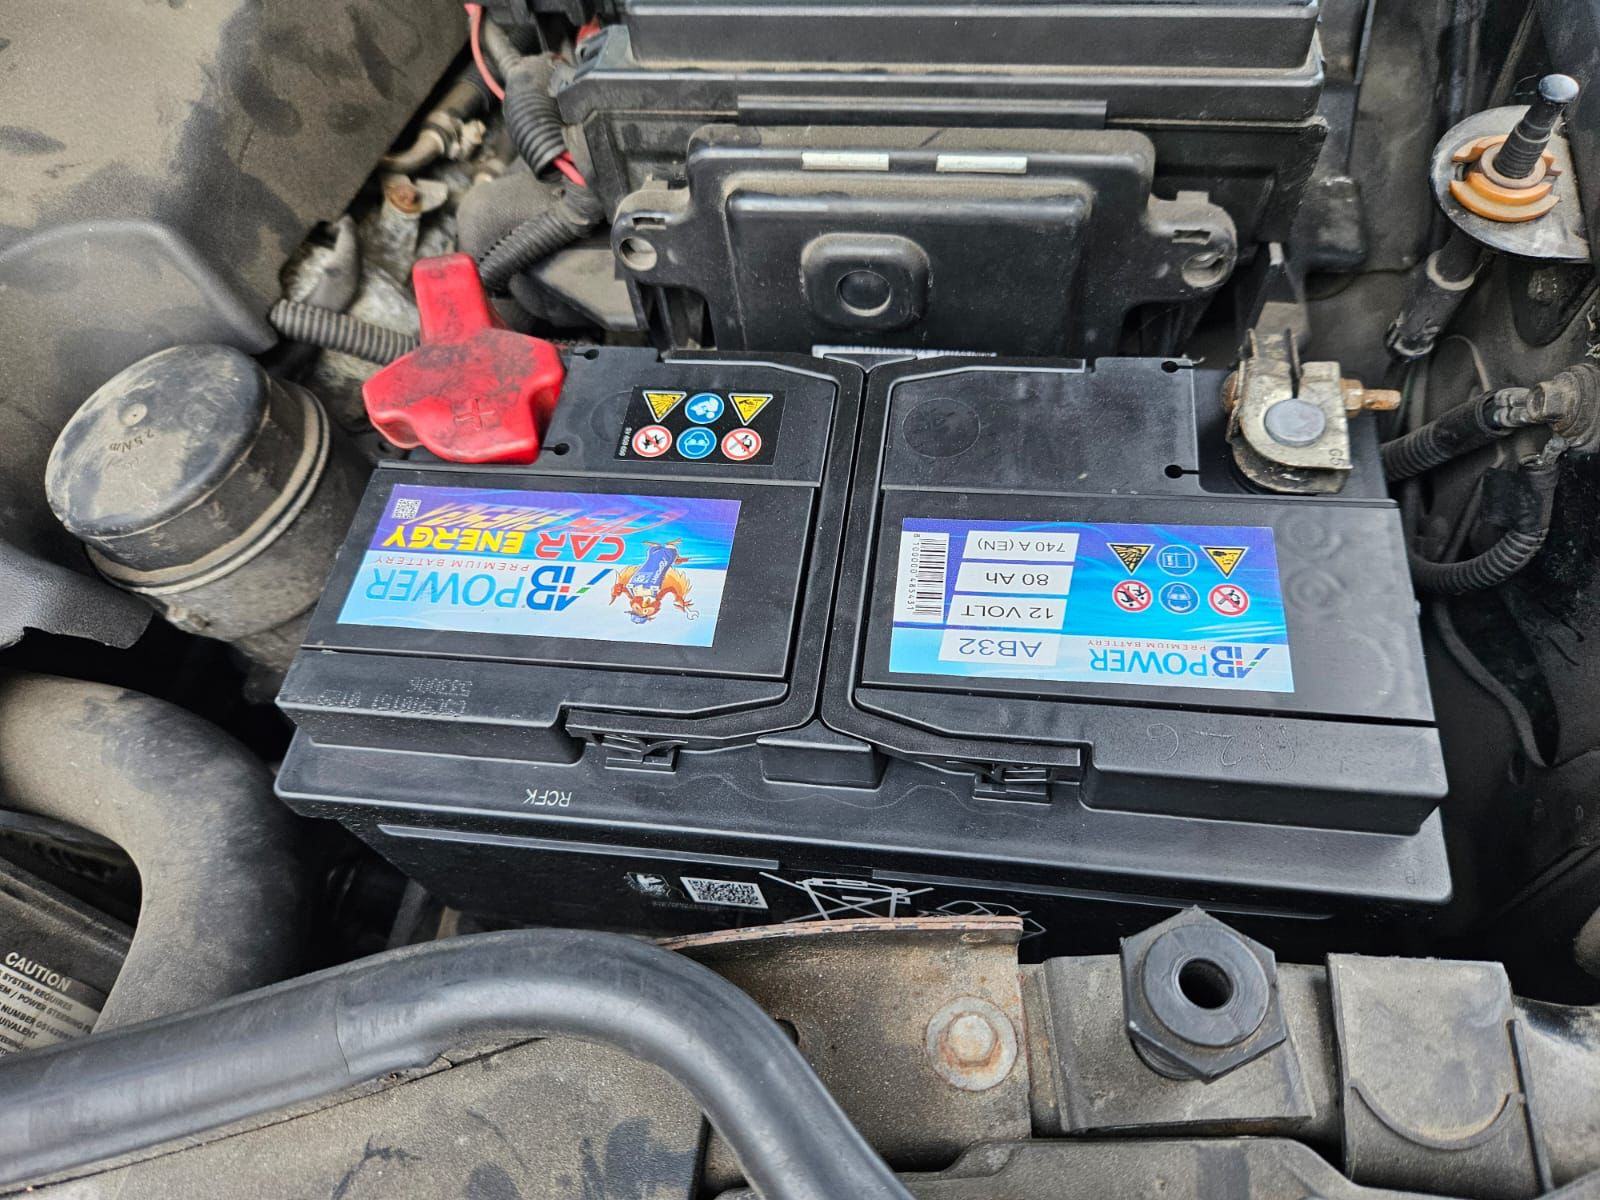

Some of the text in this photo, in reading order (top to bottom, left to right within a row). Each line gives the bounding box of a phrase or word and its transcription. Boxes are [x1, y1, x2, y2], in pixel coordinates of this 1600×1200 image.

[382, 525, 625, 561] CAR ENERGY
[978, 537, 1066, 553] 740 A (EN)
[375, 556, 530, 572] PREMIUM BATTERY
[365, 567, 525, 609] POWER
[986, 572, 1049, 586] 80 Ah
[961, 604, 1054, 620] 12 VOLT
[958, 638, 1042, 658] AB32
[1087, 639, 1207, 651] PREMIUM BATTERY
[1089, 648, 1208, 677] POWER
[522, 788, 573, 808] RCFK
[5, 951, 72, 993] CAUTION
[0, 983, 12, 996] EM
[17, 993, 47, 1012] POWER
[2, 973, 74, 1012] SYSTEM REQUIRES
[0, 1004, 37, 1025] NUMBER
[0, 1016, 39, 1040] UIVALENT
